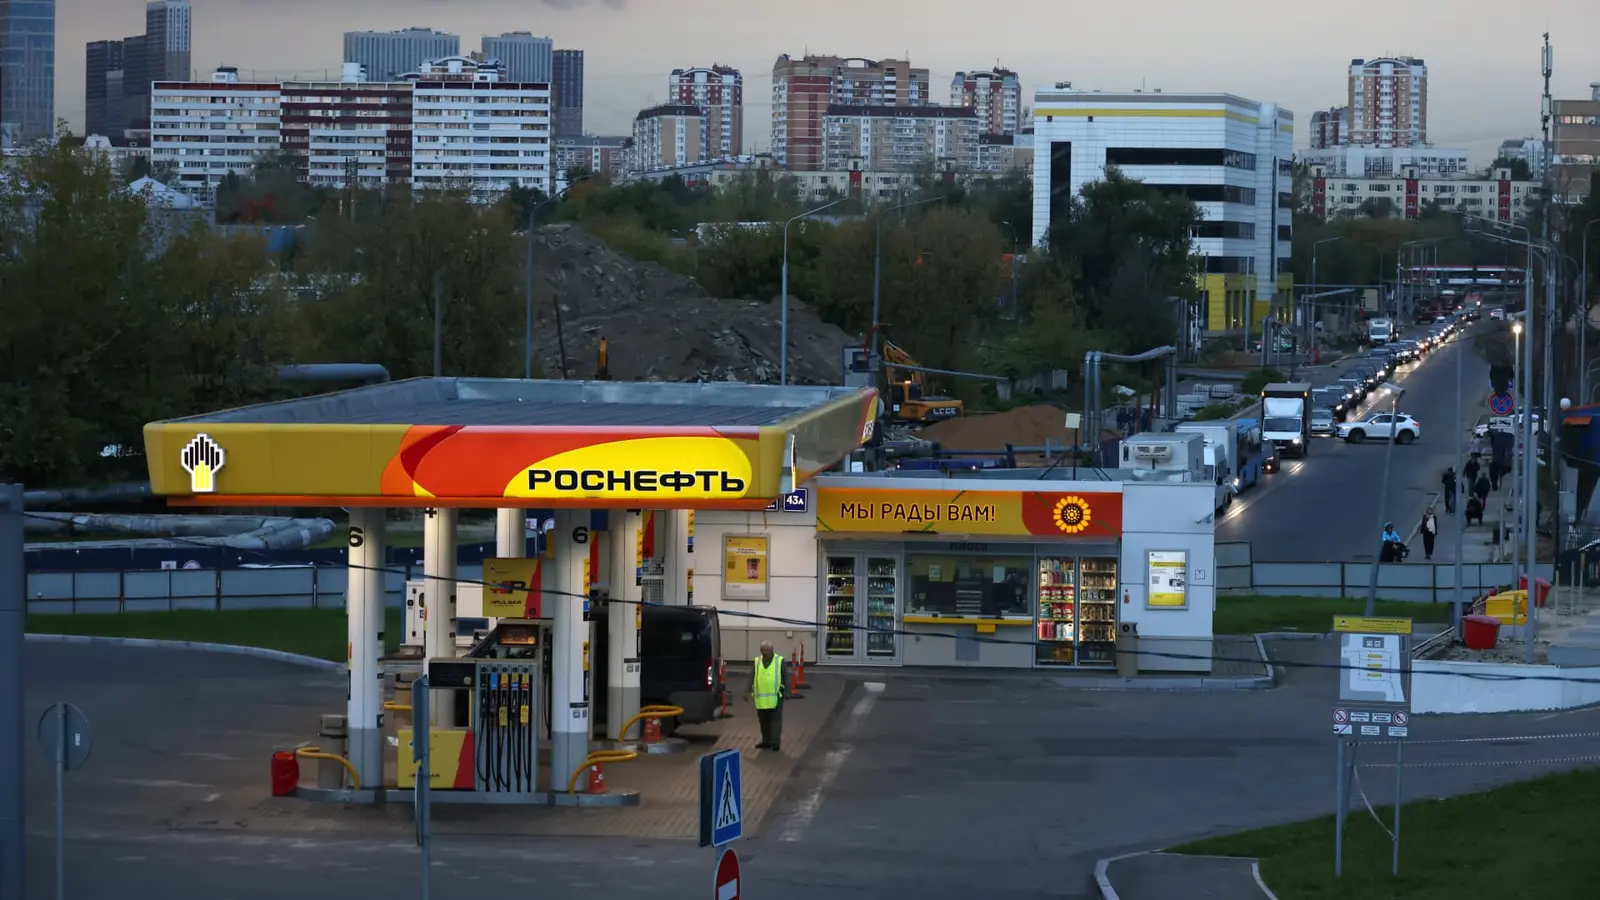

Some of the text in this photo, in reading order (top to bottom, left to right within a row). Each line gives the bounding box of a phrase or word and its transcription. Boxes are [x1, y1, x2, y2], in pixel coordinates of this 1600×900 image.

[528, 470, 745, 492] РОСНЕФТЬ
[840, 502, 995, 523] МЫ РАДЫ ВАМ!
[348, 526, 363, 547] 6
[573, 527, 588, 543] 6
